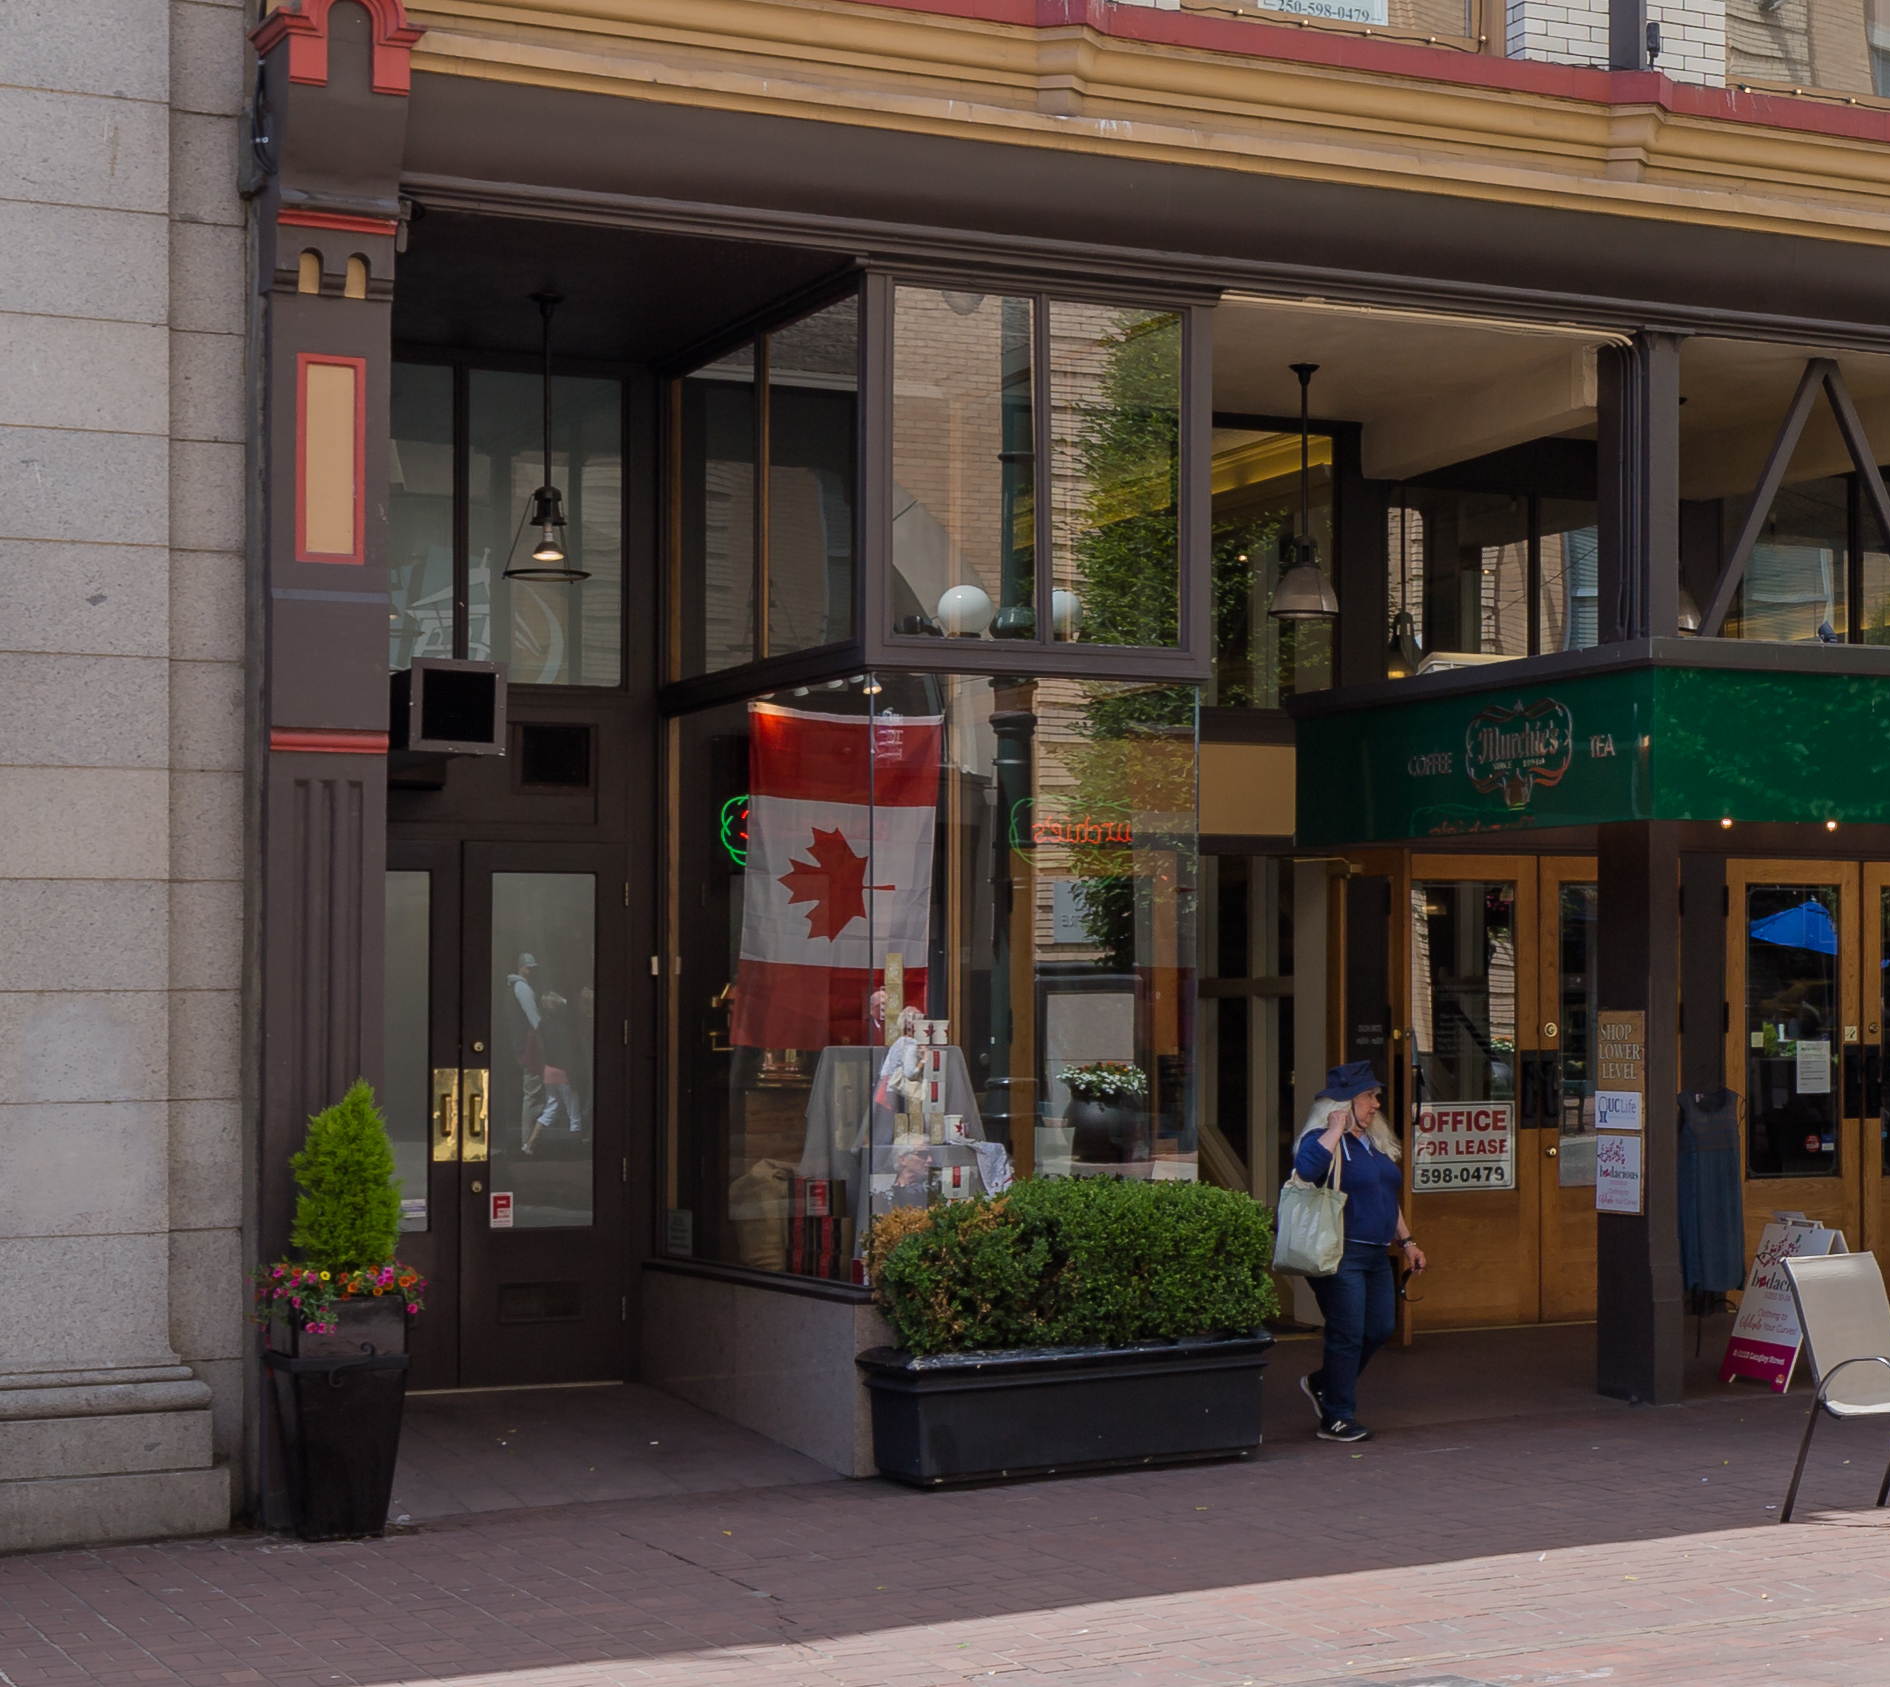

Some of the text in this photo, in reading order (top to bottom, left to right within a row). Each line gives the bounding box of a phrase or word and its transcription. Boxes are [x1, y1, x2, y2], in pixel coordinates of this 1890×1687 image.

[1407, 719, 1617, 777] COFFEE Murchie's TEA
[1600, 1023, 1632, 1041] SHOP
[1598, 1043, 1641, 1060] LOWER
[1602, 1062, 1637, 1080] LEVEL
[1418, 1109, 1508, 1134] OFFICE
[1416, 1139, 1509, 1157] FOR LEASE
[1420, 1166, 1505, 1185] 598-0479
